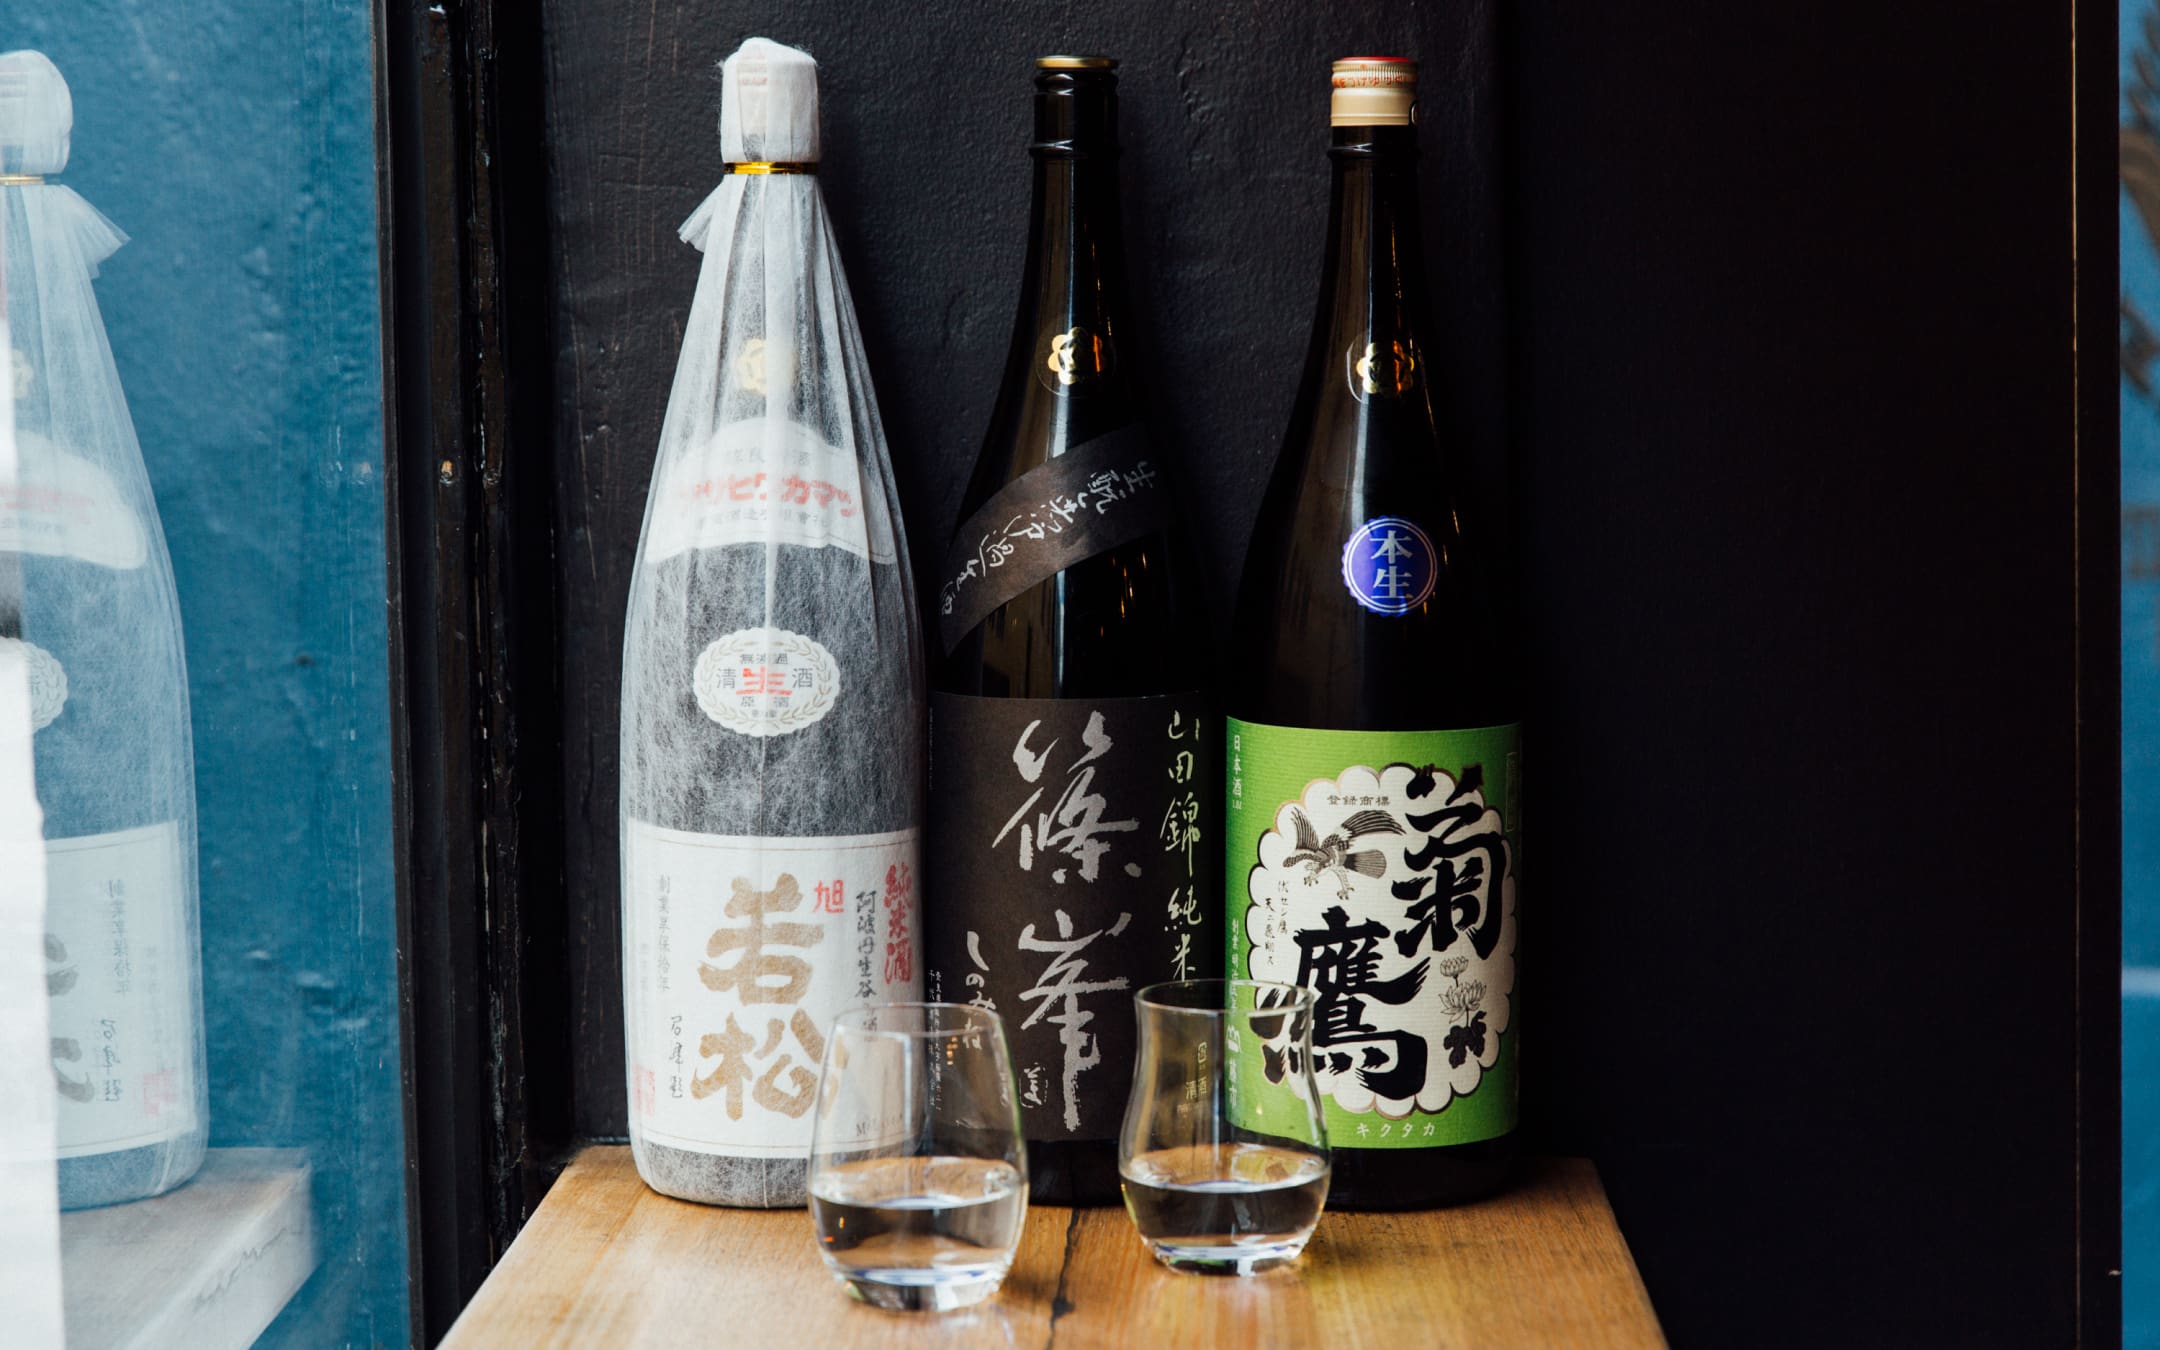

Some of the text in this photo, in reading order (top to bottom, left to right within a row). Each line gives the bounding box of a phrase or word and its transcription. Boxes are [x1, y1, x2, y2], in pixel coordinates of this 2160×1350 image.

[1370, 530, 1413, 598] 本生
[813, 880, 845, 913] 旭
[690, 872, 824, 1121] 若松
[1357, 1122, 1435, 1138] キクタカ
